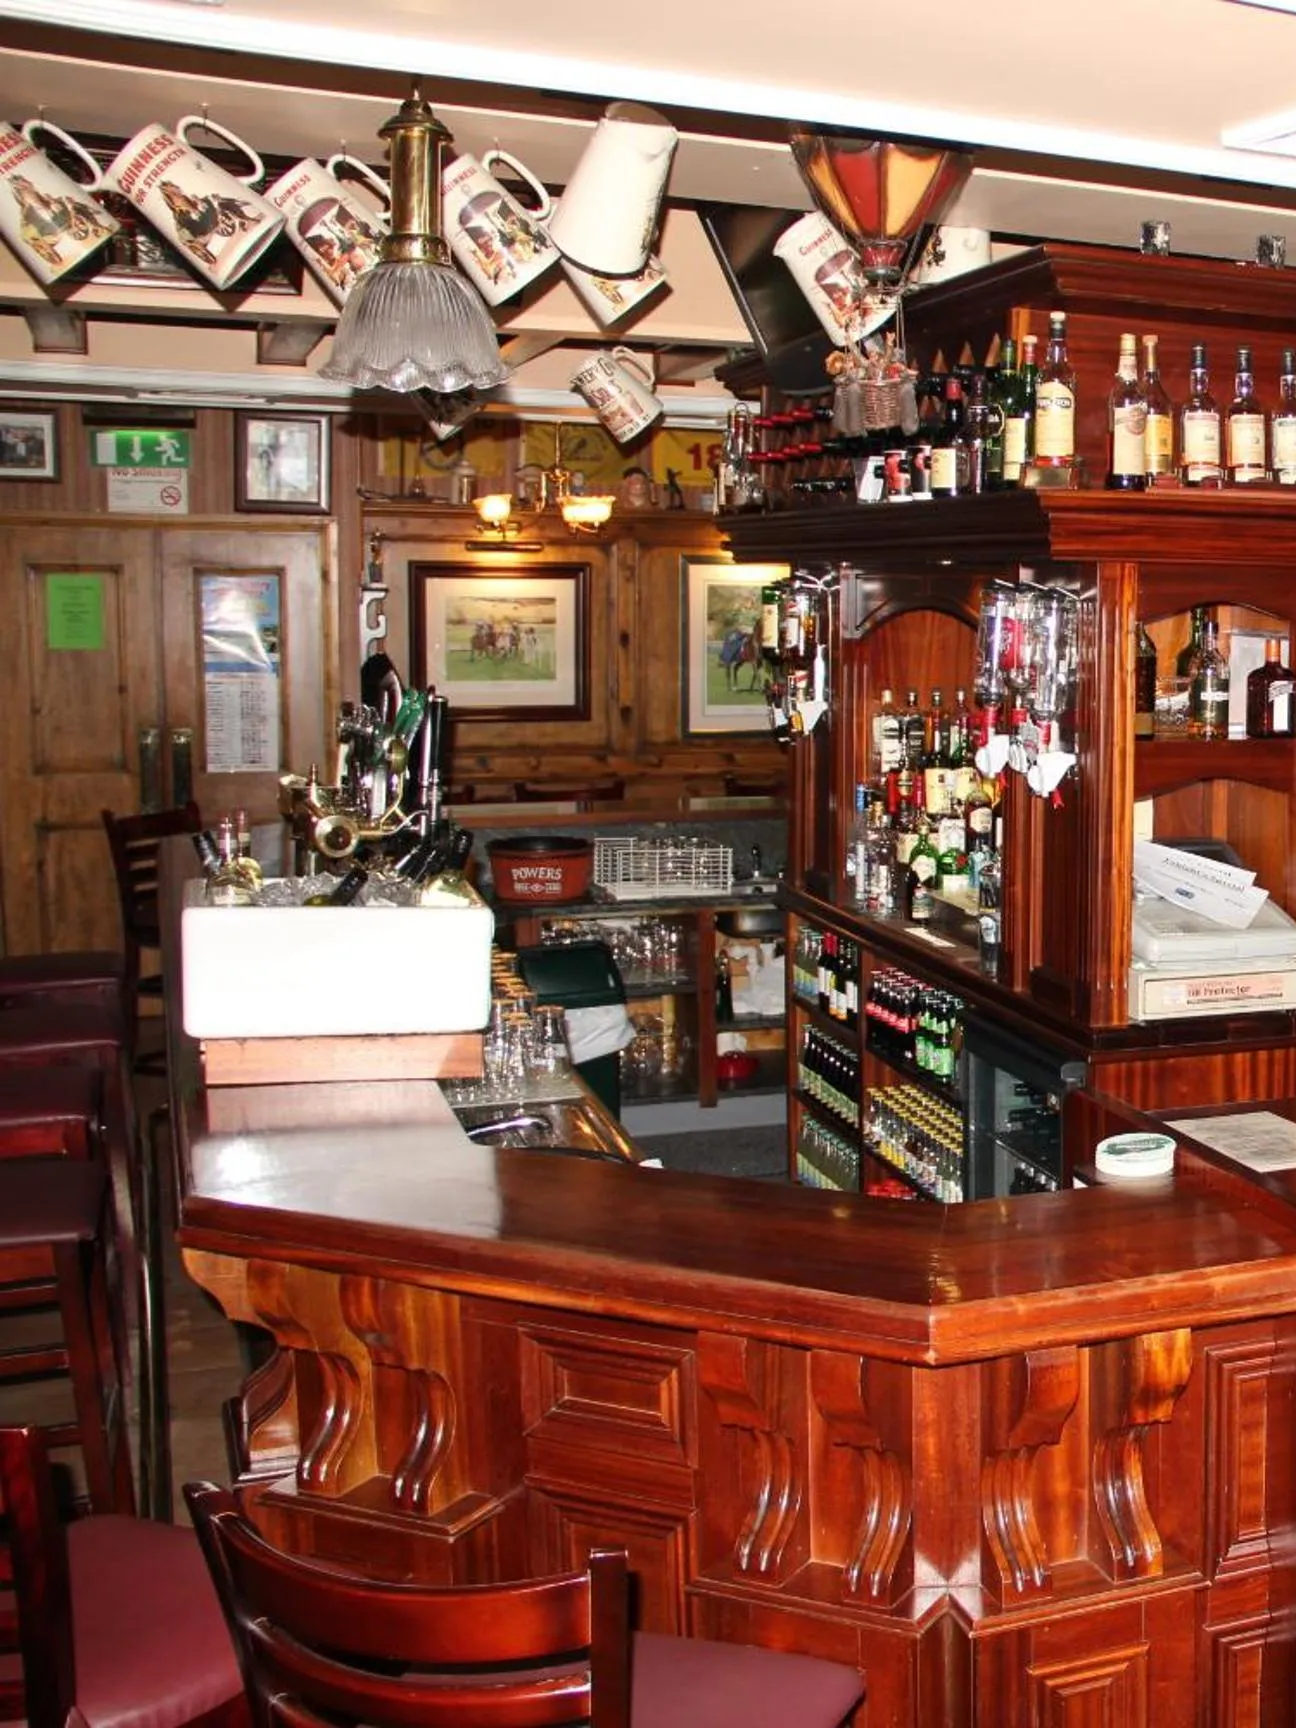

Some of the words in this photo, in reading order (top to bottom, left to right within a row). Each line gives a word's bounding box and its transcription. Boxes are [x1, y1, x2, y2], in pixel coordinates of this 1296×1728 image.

[117, 133, 175, 194] GUINNESS
[143, 147, 187, 190] STRENGTH
[274, 174, 312, 208] GUINNESS
[512, 866, 562, 880] POWERS
